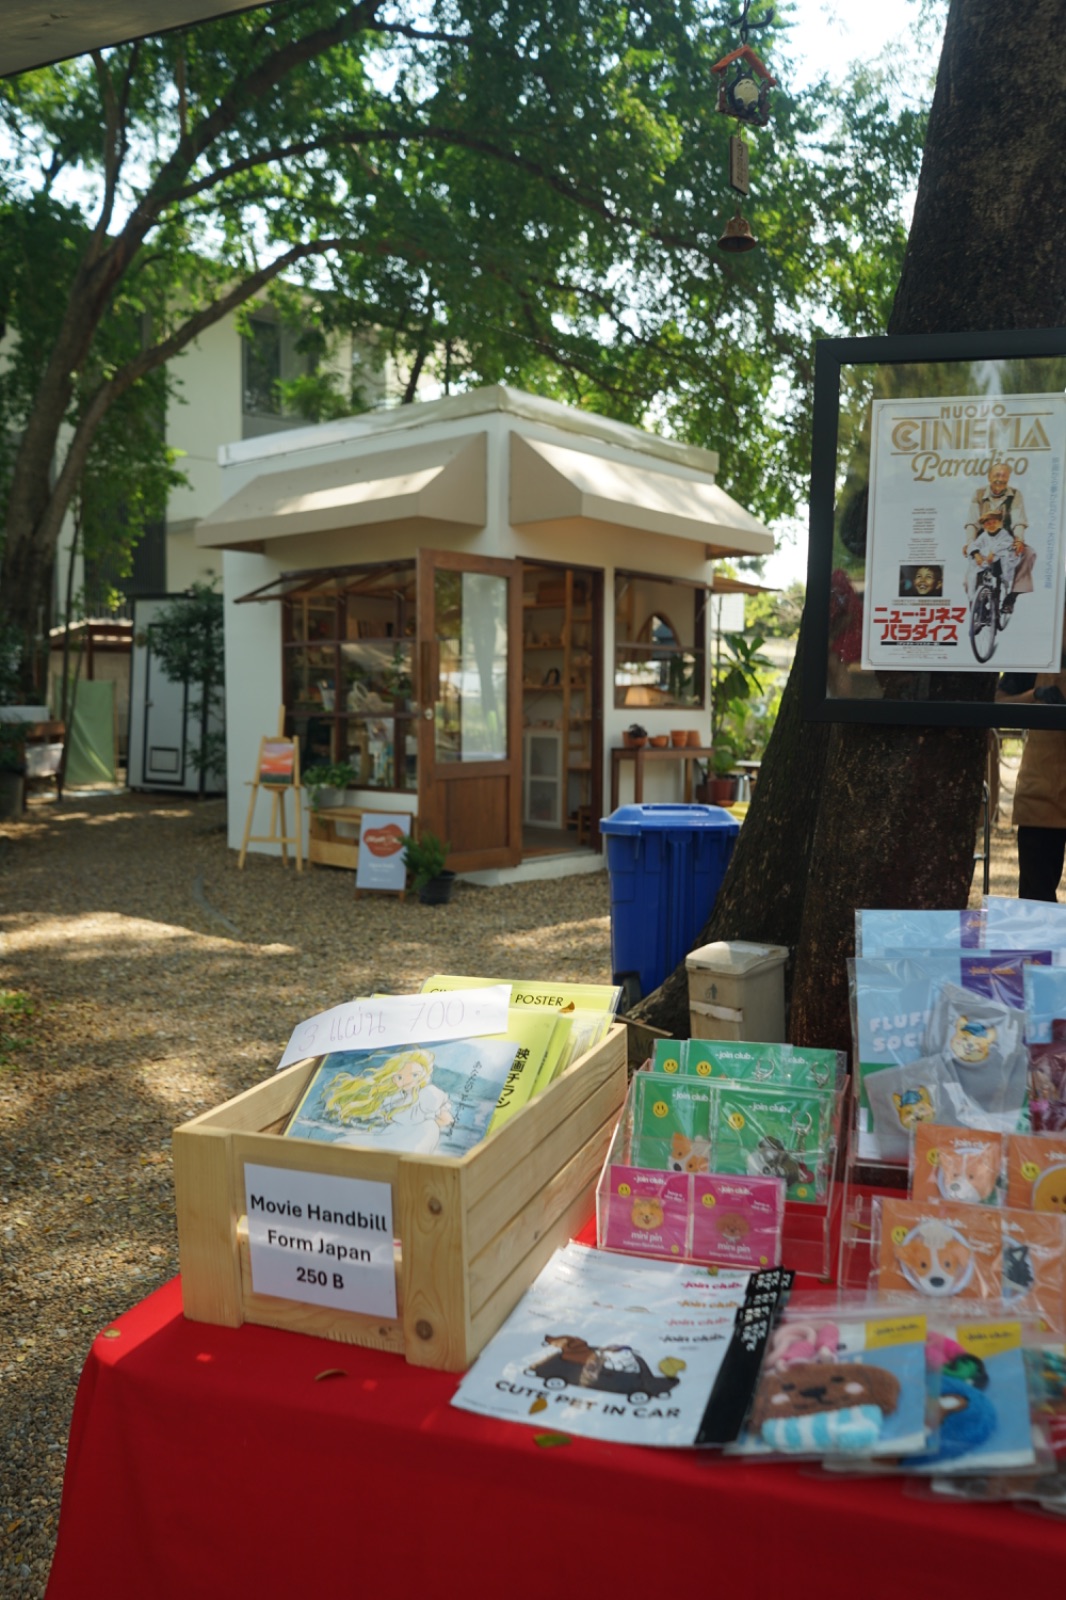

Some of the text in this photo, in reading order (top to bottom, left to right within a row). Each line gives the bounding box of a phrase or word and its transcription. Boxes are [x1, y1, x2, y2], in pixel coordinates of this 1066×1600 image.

[940, 404, 1006, 419] NUOVO
[891, 417, 1051, 451] CINEMA
[880, 624, 959, 641] パラダイス
[514, 993, 564, 1007] POSTER
[300, 1024, 319, 1050] 3
[496, 1047, 531, 1109] 映画チラシ
[250, 1194, 387, 1232] Movie Handbill
[267, 1229, 371, 1263] Form Japan
[296, 1267, 344, 1290] 250 B
[495, 1380, 681, 1419] CUTE PET IN CAR
